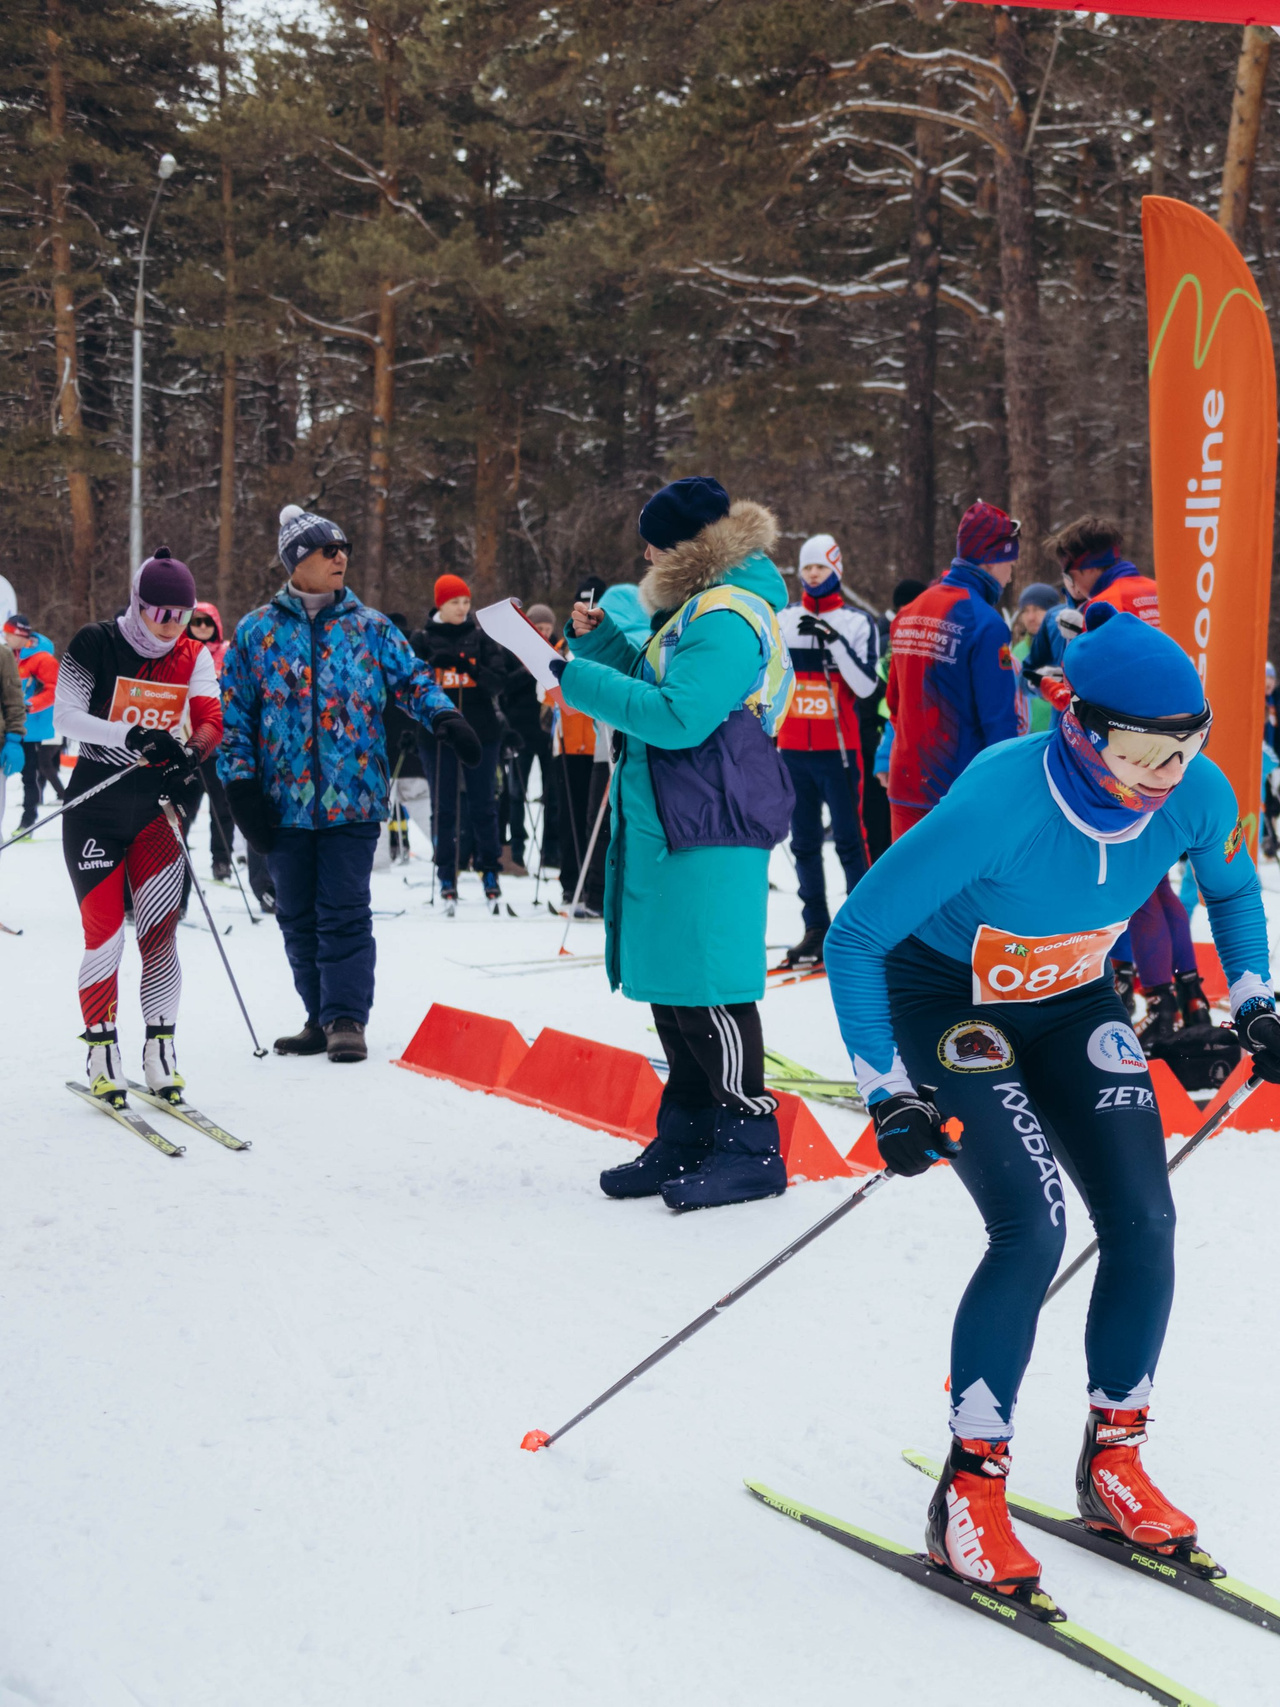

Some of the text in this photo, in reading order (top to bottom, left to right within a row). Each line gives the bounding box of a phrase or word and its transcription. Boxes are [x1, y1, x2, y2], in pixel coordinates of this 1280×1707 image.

[926, 630, 949, 645] КЛУБ
[144, 689, 178, 700] Goodline
[796, 697, 828, 715] 129
[122, 706, 174, 729] 085
[78, 859, 114, 871] Löffler
[1033, 933, 1098, 954] Goodline
[988, 954, 1091, 992] 084
[992, 1082, 1066, 1227] КУЗБАСС
[1098, 1468, 1143, 1514] alpina
[1131, 1553, 1177, 1578] FISCHER
[970, 1591, 1018, 1620] FISCHER
